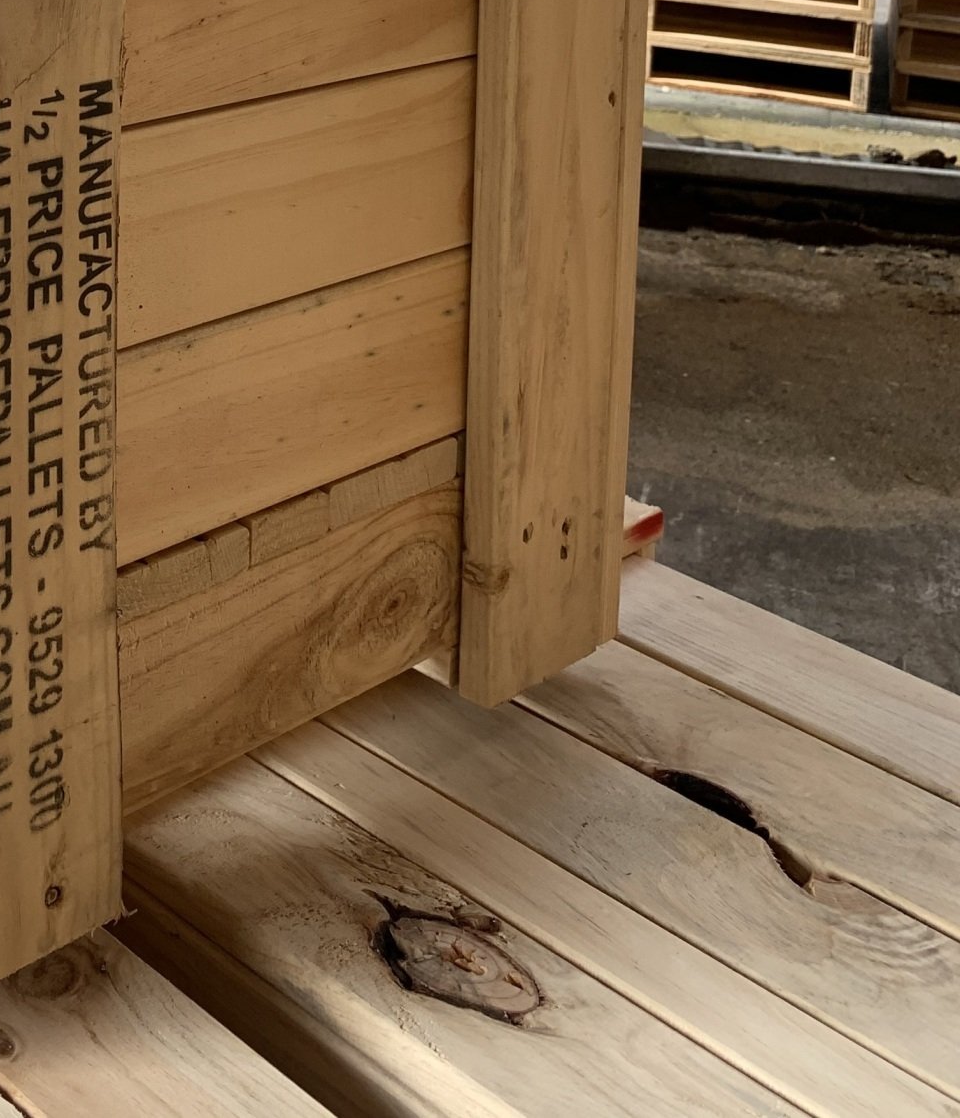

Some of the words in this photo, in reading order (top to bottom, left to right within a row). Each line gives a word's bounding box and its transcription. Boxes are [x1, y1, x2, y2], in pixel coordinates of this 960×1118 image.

[27, 157, 63, 311] PRICE
[78, 79, 113, 482] MANUFACTURED
[28, 334, 64, 558] PALLETS
[79, 494, 113, 552] BY
[28, 606, 63, 715] 9529
[29, 729, 64, 833] 1300
